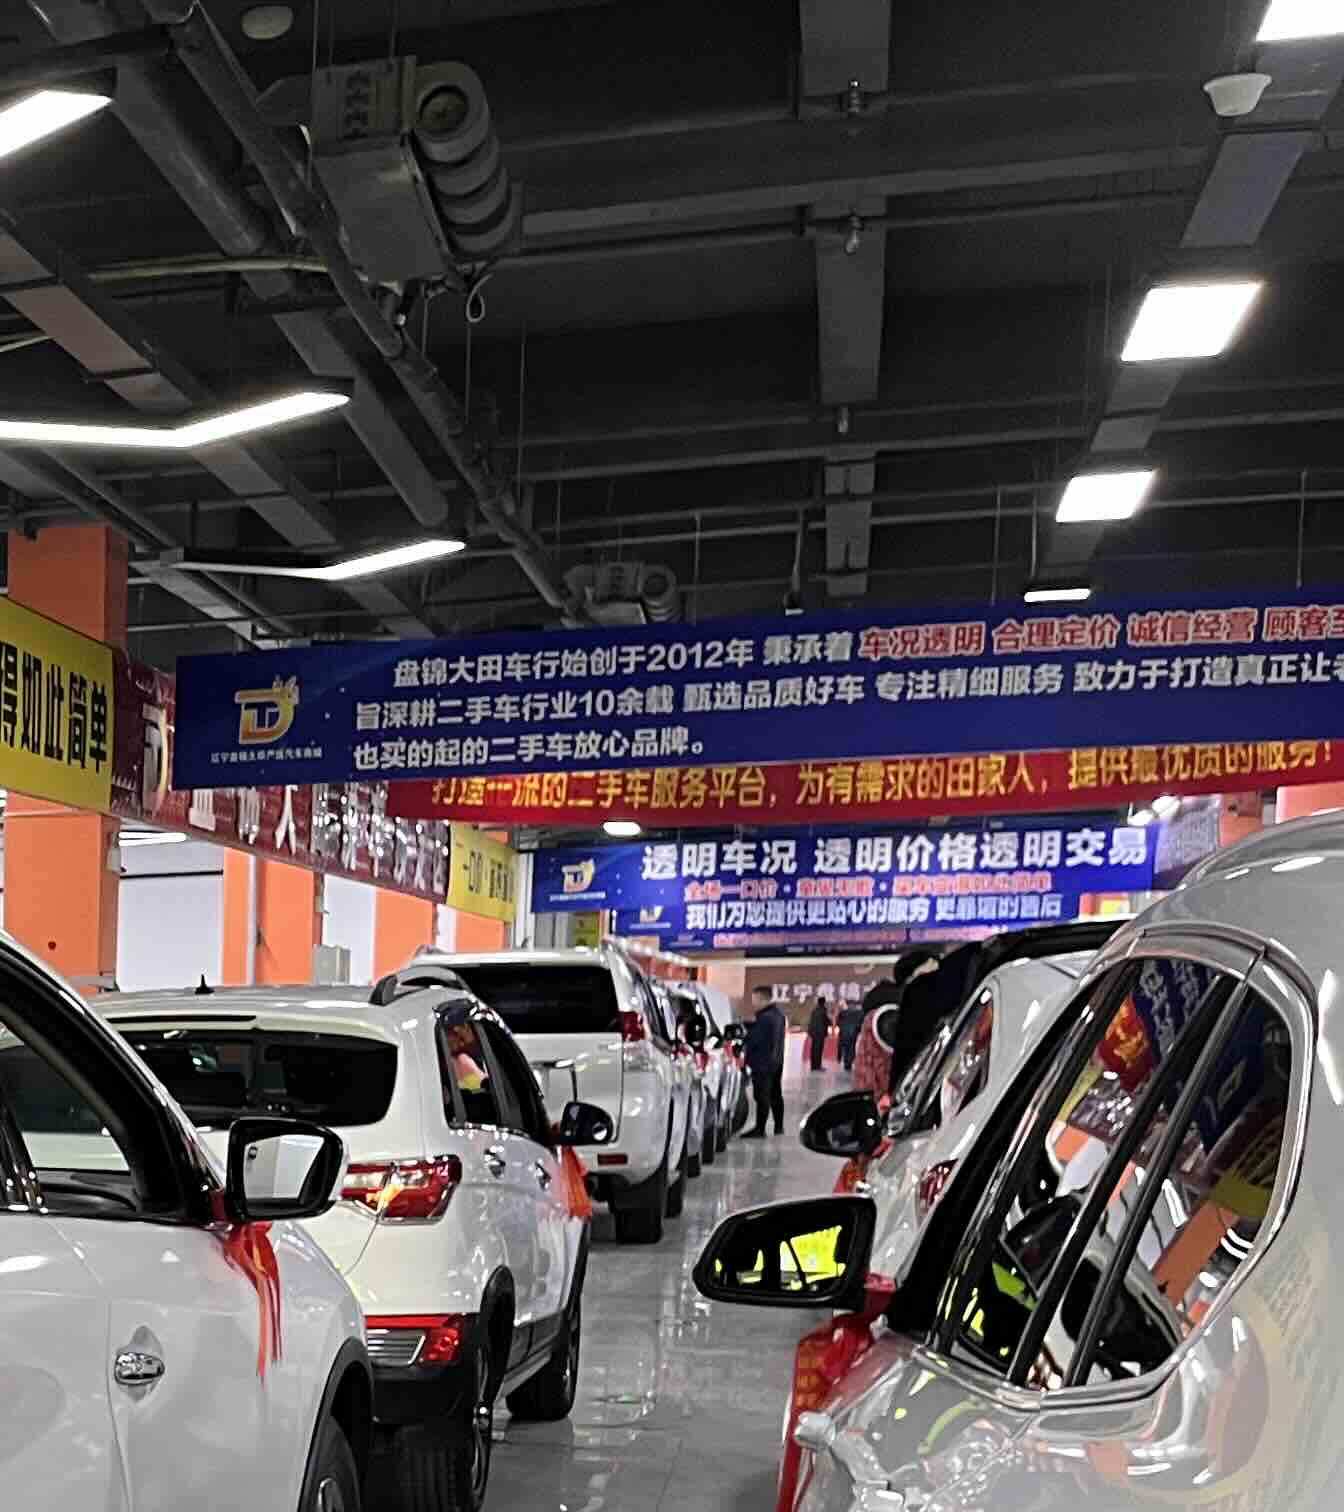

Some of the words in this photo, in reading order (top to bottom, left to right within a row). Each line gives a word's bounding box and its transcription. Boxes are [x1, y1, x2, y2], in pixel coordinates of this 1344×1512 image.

[393, 638, 754, 688] 盘锦大田车行始创于2012年
[858, 620, 986, 661] 车况透明
[992, 612, 1120, 655] 合理定价
[1126, 607, 1258, 649] 诚信经营
[356, 684, 674, 731] 旨深耕二手车行业10余载
[683, 674, 865, 713] 甄选品质好车
[875, 663, 1064, 702] 专注精细服务
[353, 725, 703, 771] 也买的起的二手车放心品牌。
[641, 838, 798, 881] 透明车况
[813, 826, 1148, 875] 透明价格透明交易
